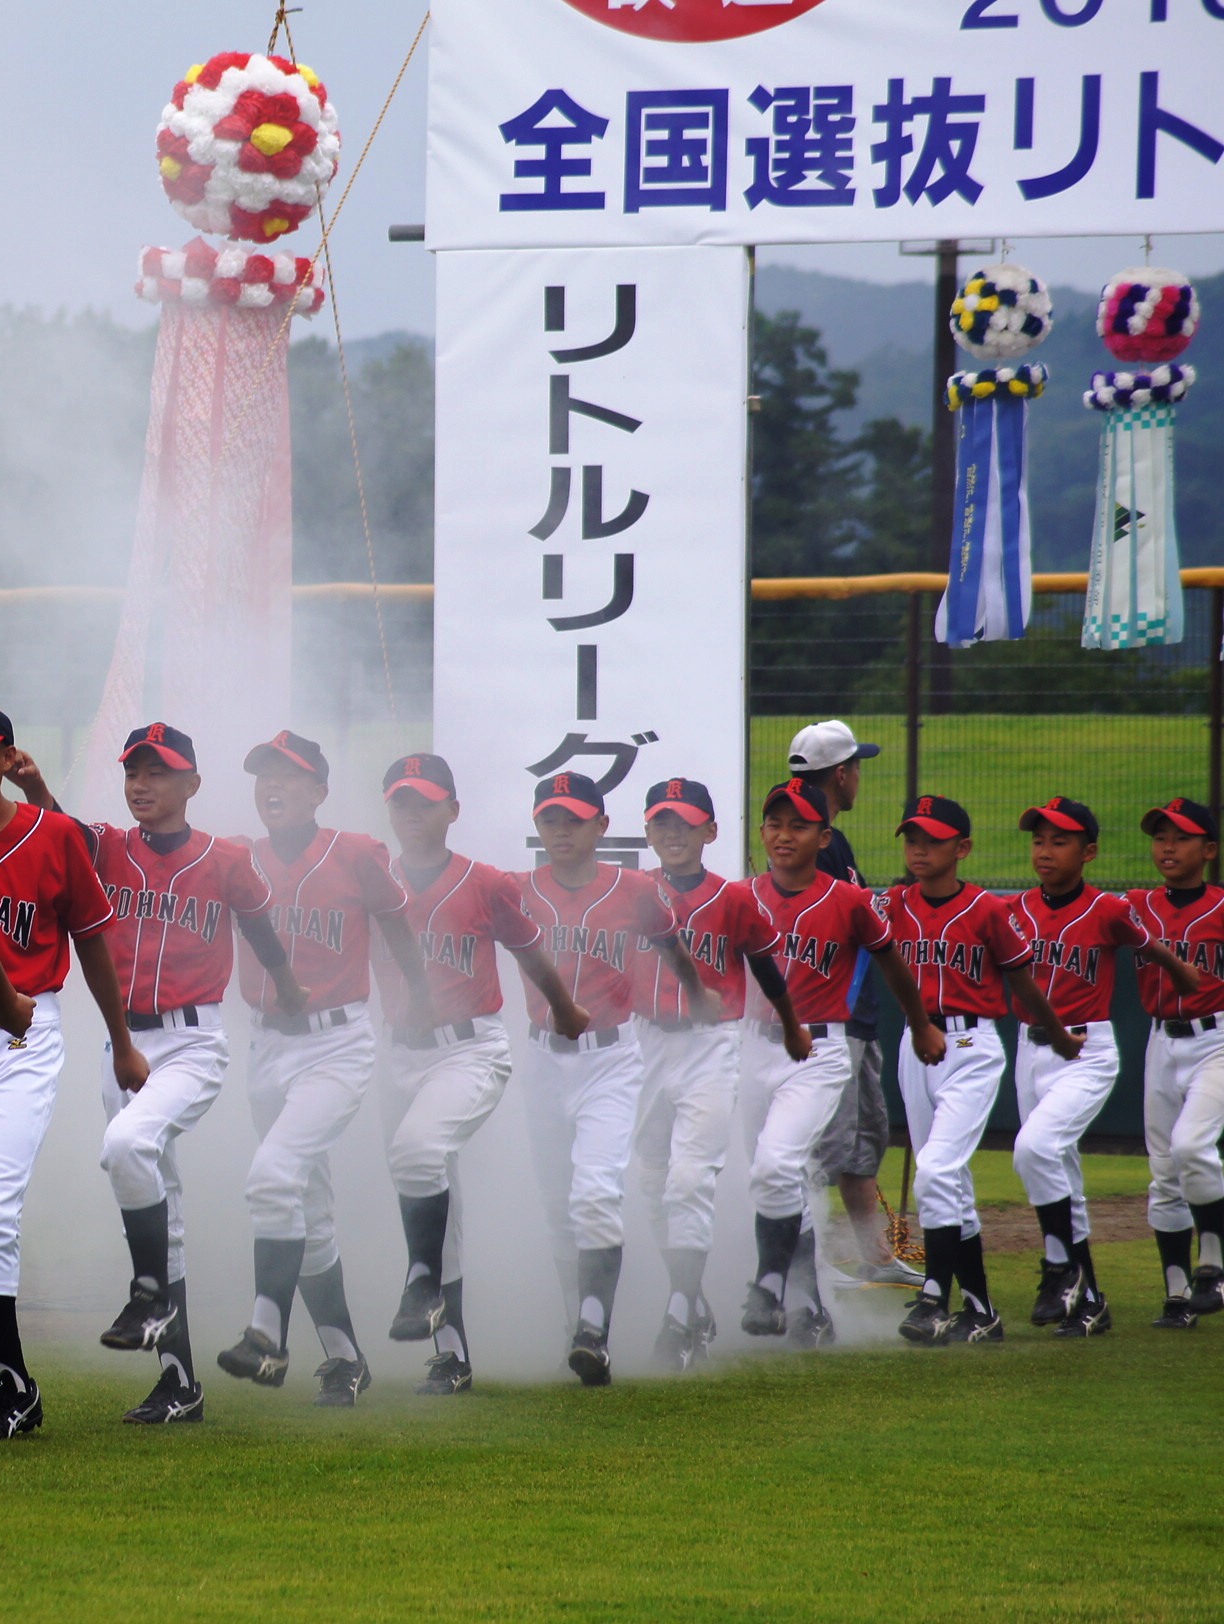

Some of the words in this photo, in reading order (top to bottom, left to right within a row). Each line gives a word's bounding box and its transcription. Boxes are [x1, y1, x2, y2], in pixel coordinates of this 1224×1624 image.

[498, 70, 1224, 214] 全国選抜リト
